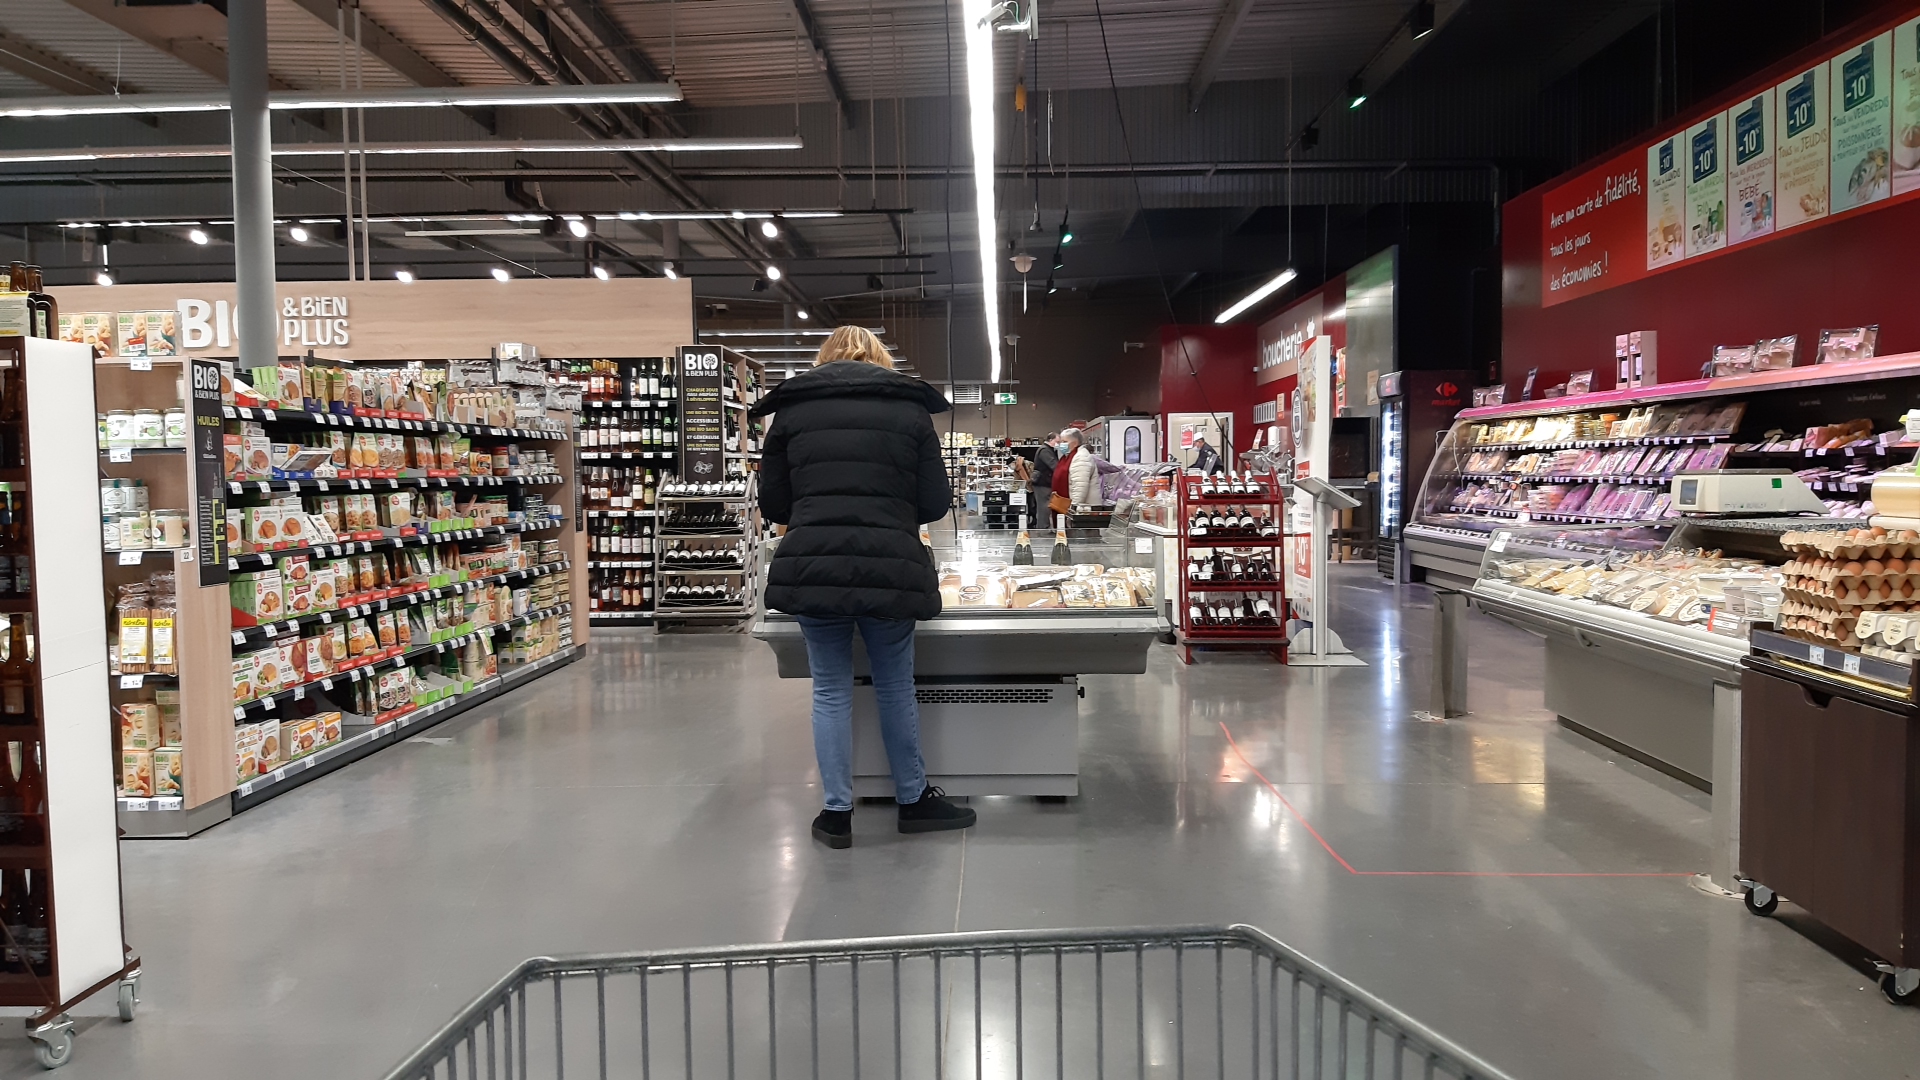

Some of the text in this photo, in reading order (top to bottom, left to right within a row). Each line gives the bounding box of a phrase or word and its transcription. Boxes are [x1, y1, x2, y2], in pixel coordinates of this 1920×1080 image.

[1833, 116, 1847, 128] Tous
[1853, 96, 1889, 120] VENDREDIS
[1778, 145, 1792, 159] Tous
[1801, 128, 1828, 153] JEUDIS
[1837, 124, 1882, 151] POISSONNERIE
[1550, 212, 1565, 229] Avec
[1565, 208, 1575, 223] ma
[1576, 197, 1593, 216] carte
[1595, 190, 1603, 208] de
[1604, 168, 1642, 206] fidélité,
[1739, 180, 1761, 201] BÉBÉ
[1550, 232, 1591, 258] tous les jours
[1550, 274, 1561, 291] des
[1561, 259, 1602, 288] économies
[283, 297, 299, 317] &
[283, 318, 349, 346] PLUS
[684, 353, 719, 371] BIO
[193, 364, 219, 391] BIO
[196, 415, 220, 427] HUILES
[183, 552, 190, 560] 22
